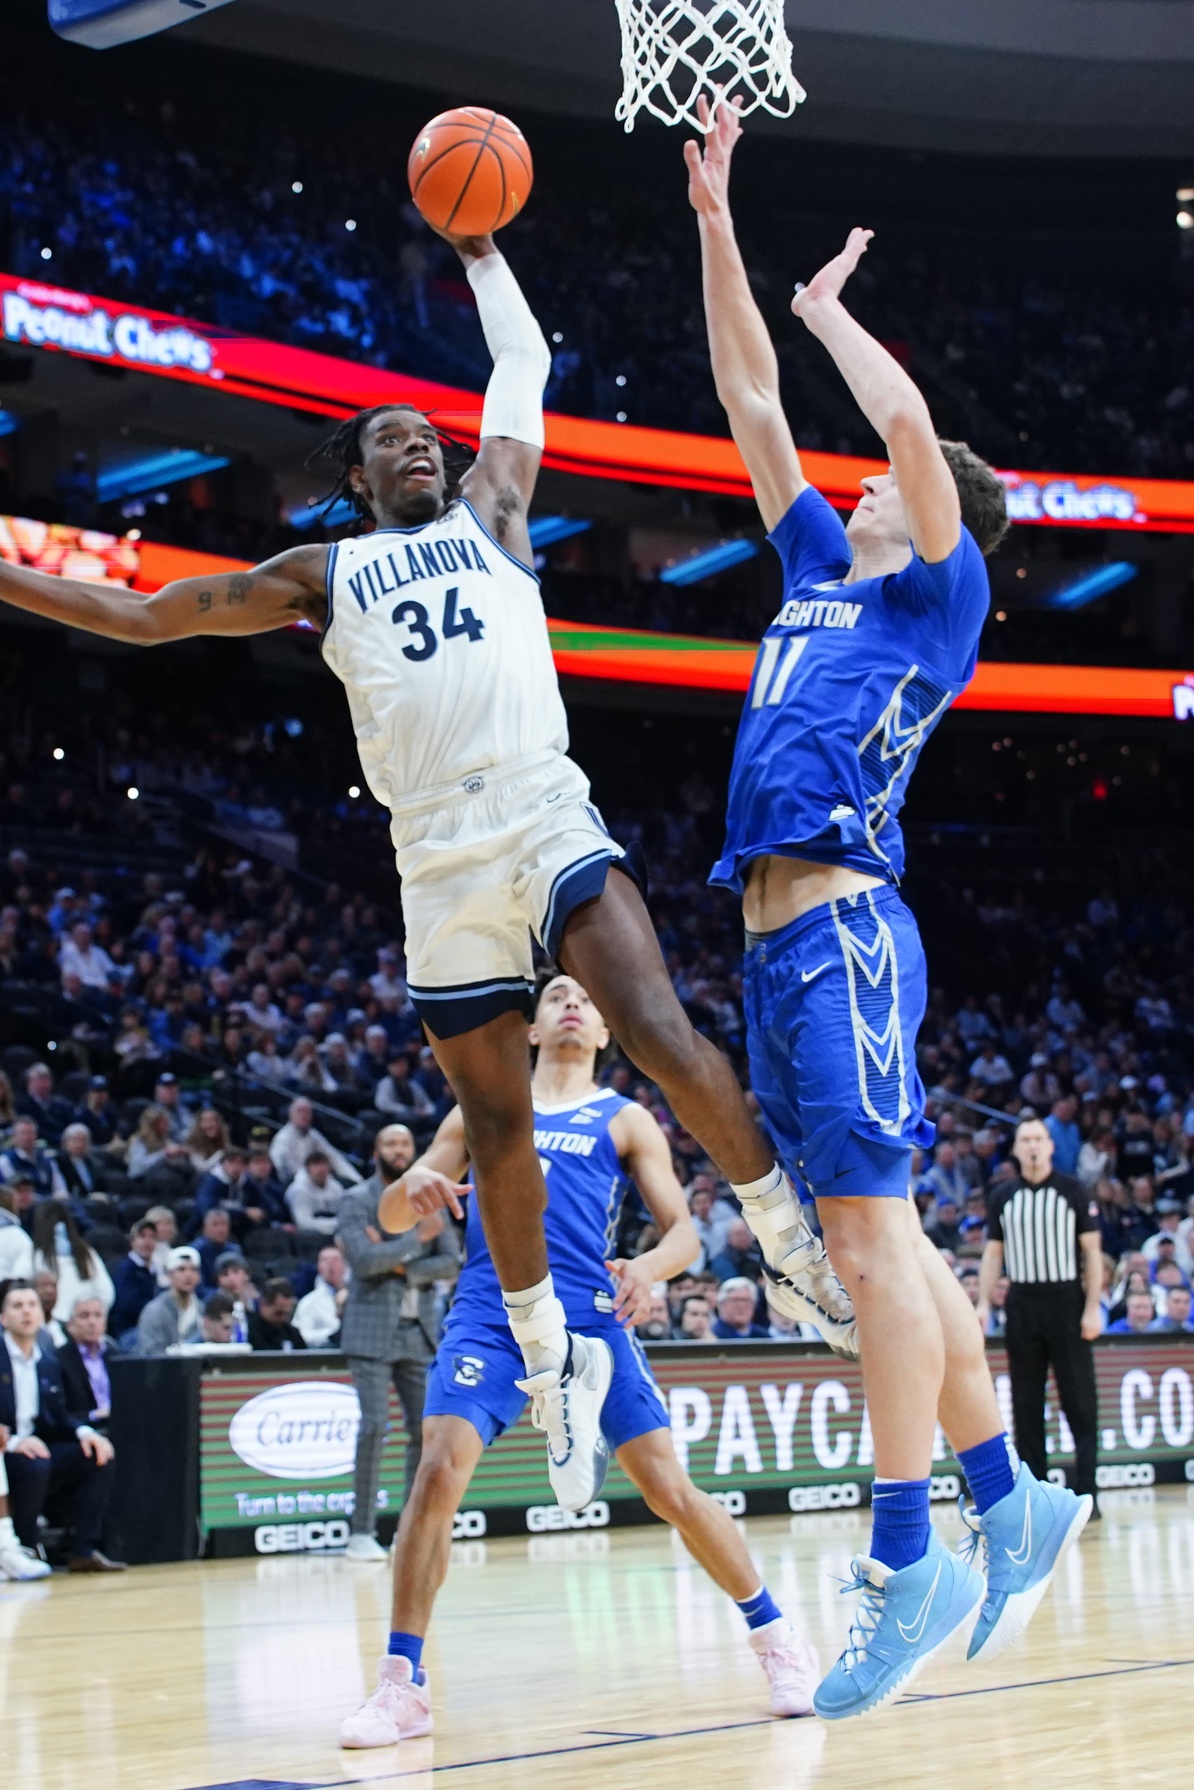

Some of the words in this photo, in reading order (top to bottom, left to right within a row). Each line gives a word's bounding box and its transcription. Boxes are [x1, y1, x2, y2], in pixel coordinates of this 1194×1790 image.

[347, 538, 494, 615] VILLANOVA
[391, 586, 486, 662] 34
[770, 599, 864, 630] GHTON
[751, 636, 809, 710] 11
[257, 1410, 357, 1447] Carrie
[1095, 1463, 1155, 1488] GEICO
[788, 1482, 861, 1512] GEICO
[255, 1520, 350, 1553] GEICO
